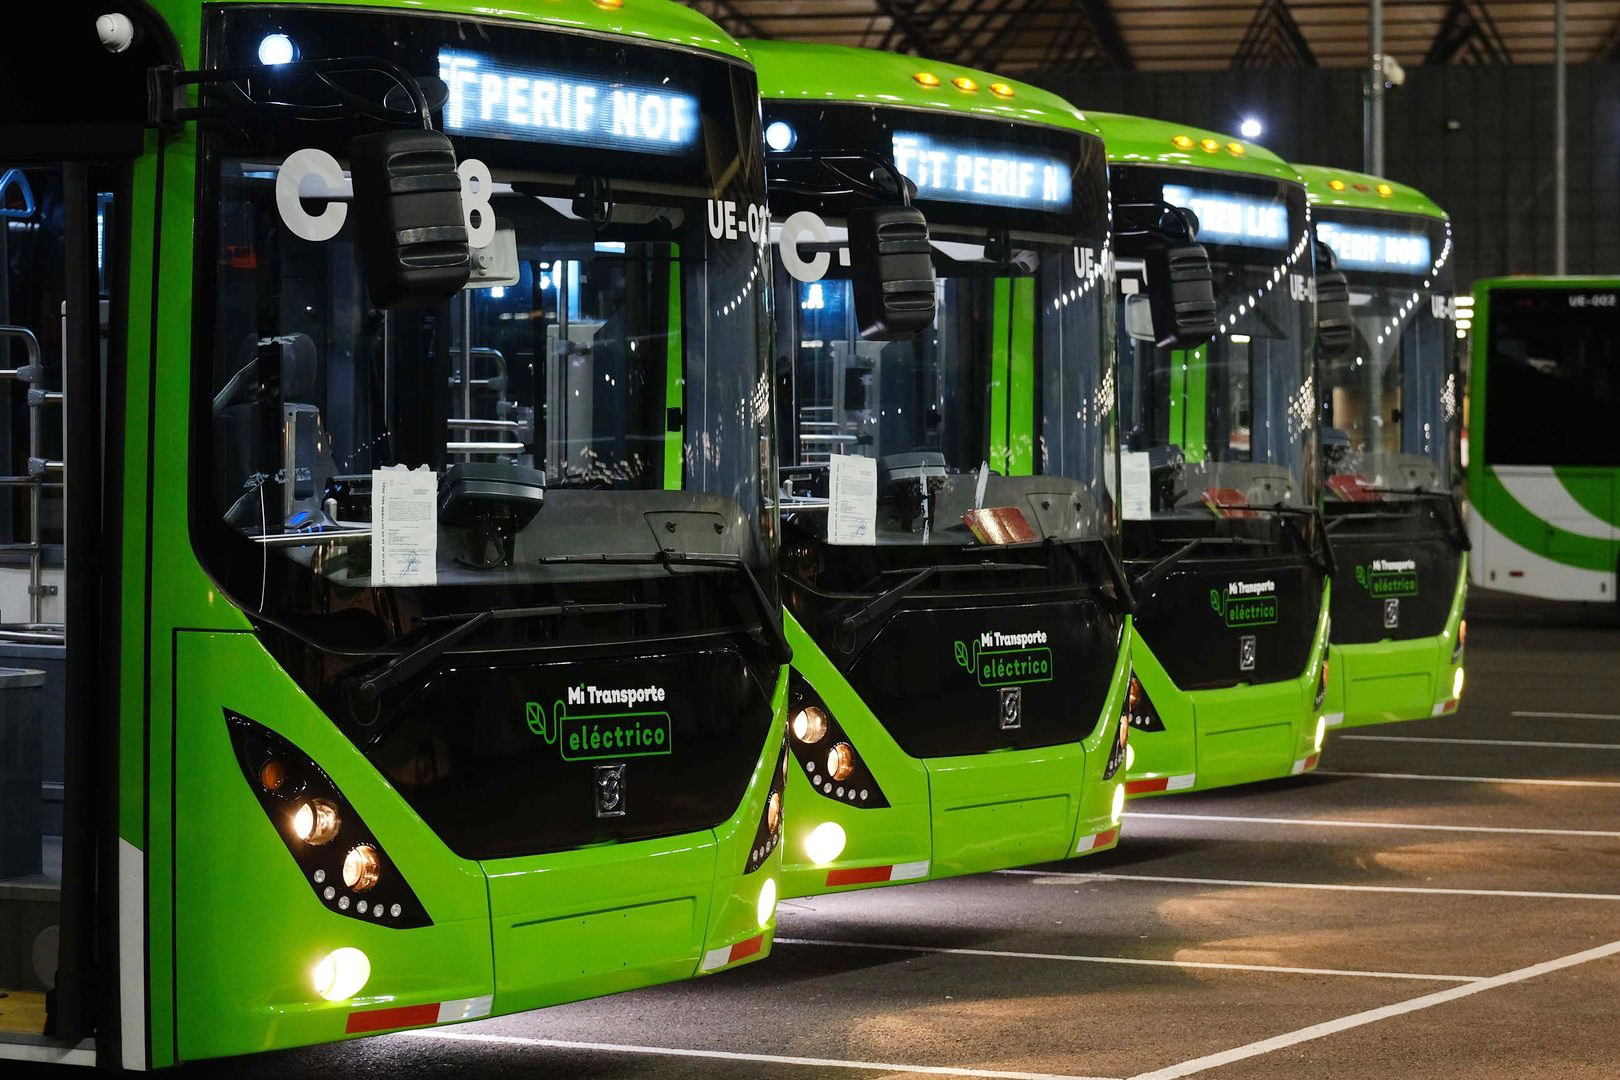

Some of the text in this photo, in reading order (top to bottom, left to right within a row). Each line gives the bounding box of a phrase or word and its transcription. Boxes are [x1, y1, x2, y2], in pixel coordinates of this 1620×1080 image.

[956, 155, 1035, 198] PERIF
[1238, 580, 1275, 595] Transporte
[1230, 603, 1274, 620] eléctrico
[981, 630, 1047, 649] Mi Transporte
[984, 656, 1048, 678] eléctrico
[568, 683, 665, 708] Mi Transporte
[569, 722, 665, 750] eléctrico
